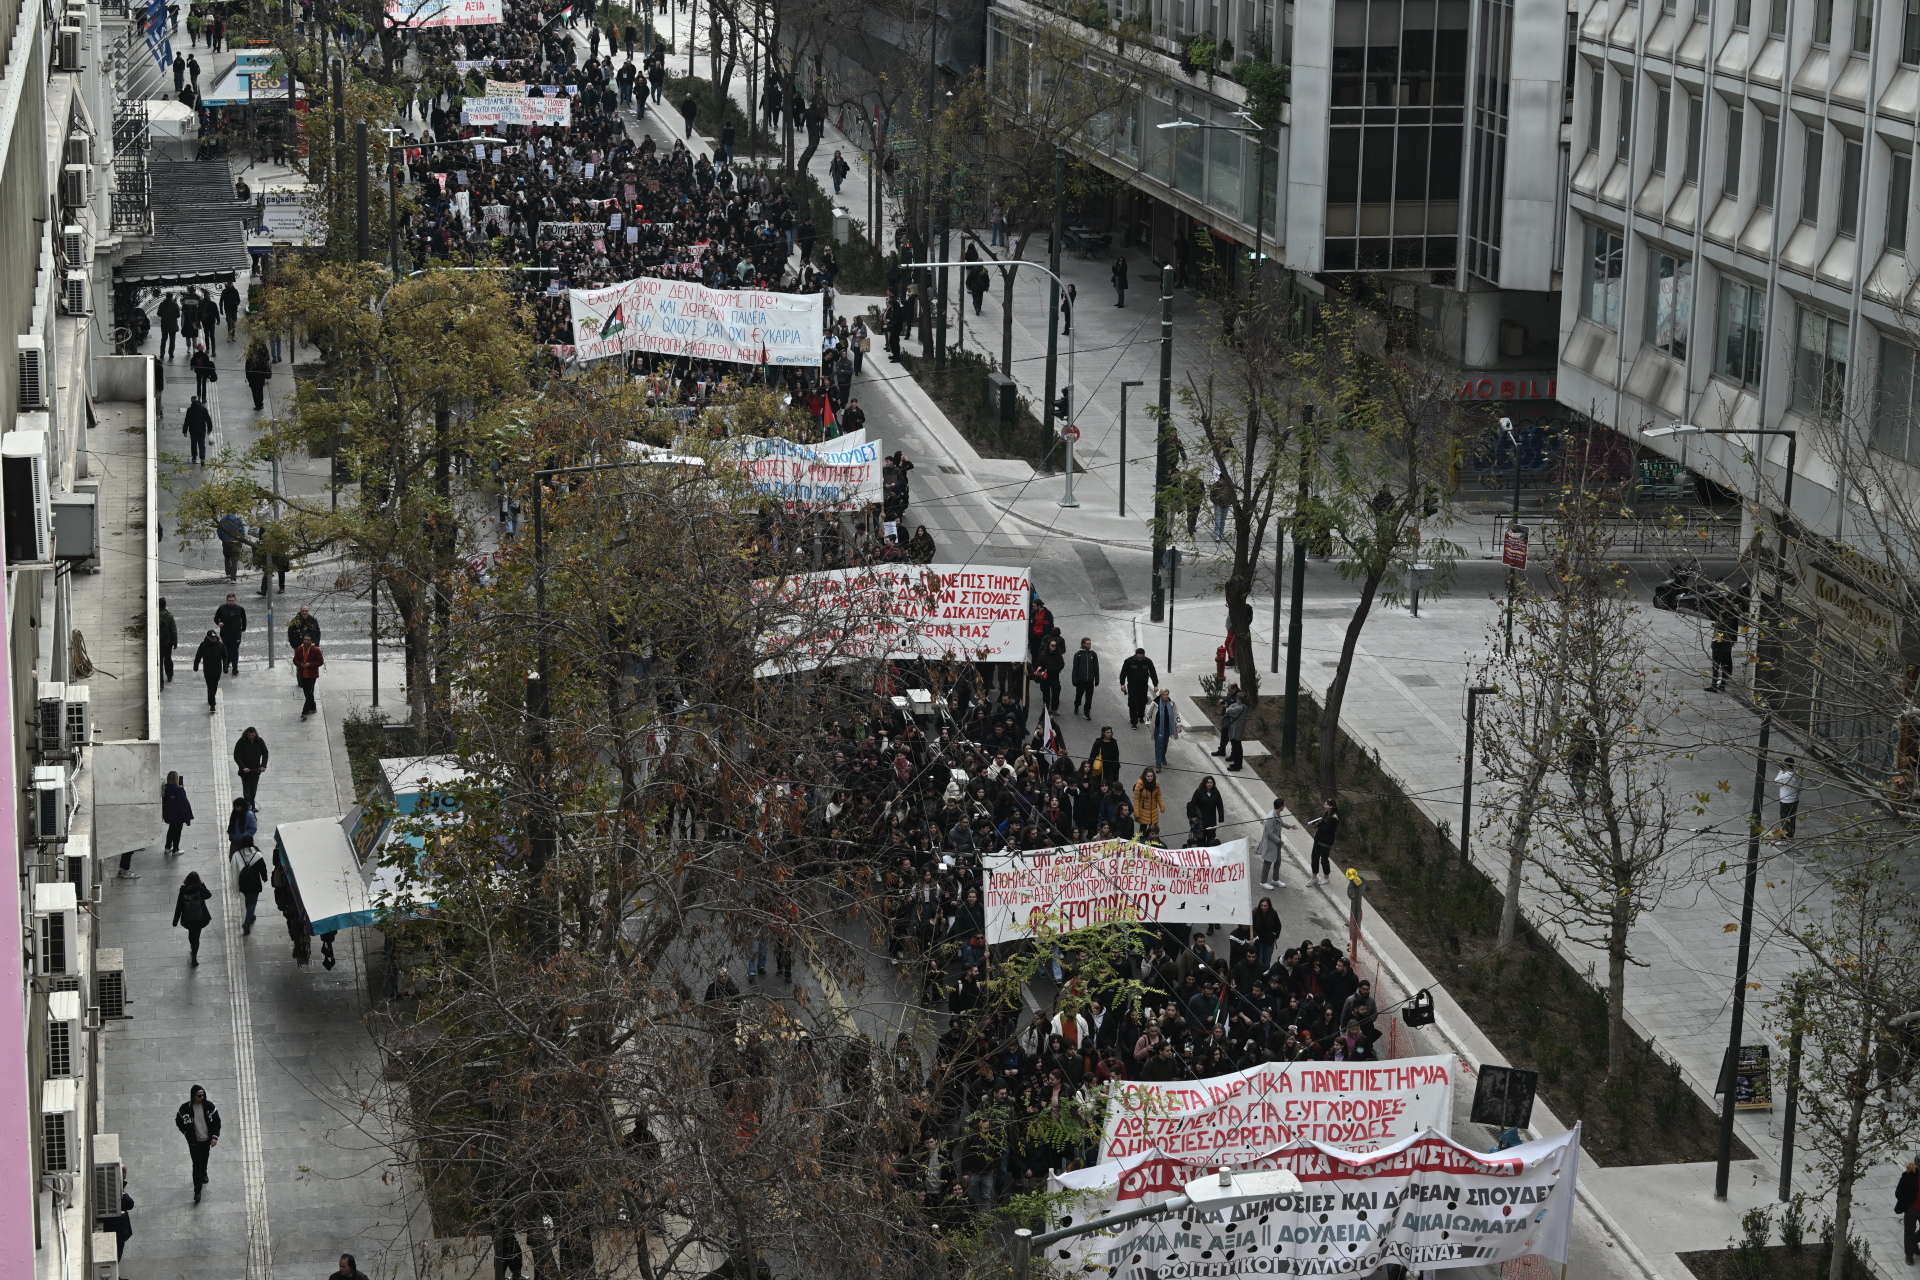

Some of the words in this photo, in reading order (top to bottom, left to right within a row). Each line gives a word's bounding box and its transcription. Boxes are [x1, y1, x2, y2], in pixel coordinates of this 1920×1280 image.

[465, 1, 484, 11] ΑΞΙΑ
[514, 98, 536, 106] ΓΝΩΣΗ
[588, 285, 630, 306] ΕΧΟΥΜΕ
[634, 280, 661, 296] ΔΙΚΙΟ!
[668, 284, 694, 300] ΔΕΝ
[699, 288, 744, 309] ΚΑΝΟΥΜΕ
[660, 299, 676, 315] ΚΑΙ
[681, 301, 725, 322] ΔΩΡΕΑΝ
[731, 310, 767, 325] ΠΑΙΔΕΙΑ
[635, 312, 652, 330] ΓΙΑ
[662, 316, 700, 336] ΟΛΟΥΣ
[706, 321, 723, 338] ΚΑΙ
[728, 326, 746, 343] ΟΧΙ
[960, 590, 1021, 606] ΣΠΟΥΔΕΣ
[942, 606, 1026, 621] ΔΙΚΑΙΩΜΑΤΑ
[959, 625, 990, 639] ΜΑΣ
[1186, 862, 1245, 883] ΕΚΠΑΙΔΕΥΣΗ
[1170, 879, 1209, 895] ΔΟΥΛΕΙΑ
[1123, 1084, 1164, 1111] ΟΧΙ
[1167, 1089, 1208, 1112] ΣΤΑ
[1208, 1072, 1293, 1105] ΙΔΙΩΤΙΚΑ
[1300, 1065, 1449, 1093] ΠΑΝΕΠΙΣΤΗΜΙΑ
[1181, 1105, 1243, 1133] ΛΕΦΤΑ
[1247, 1101, 1280, 1124] ΓΙΑ
[1297, 1117, 1397, 1143] ΣΠΟΥΔΕΣ
[1123, 1164, 1163, 1192] ΟΧΙ
[1337, 1144, 1516, 1177] ΠΑΝΕΠΙΣΤΗΜΙΑ
[1229, 1194, 1336, 1223] ΔΗΜΟΣΙΕΣ
[1341, 1191, 1378, 1211] ΚΑΙ
[1382, 1183, 1461, 1209] ΔΩΡΕΑΝ
[1107, 1234, 1168, 1266] ΠΤΥΧΙΑ
[1173, 1232, 1202, 1250] ΜΕ
[1207, 1230, 1256, 1251] ΑΞΙΑ
[1277, 1223, 1372, 1245] ΔΟΥΛΕΙΑ
[1376, 1217, 1397, 1240] ΜΕ
[1401, 1211, 1528, 1234] ΔΙΚΑΙΩΜΑΤΑ
[1156, 1255, 1280, 1279] ΦΟΙΤΗΤΙΚΟΙ
[1385, 1240, 1463, 1264] ΑΘΗΝΑΣ
